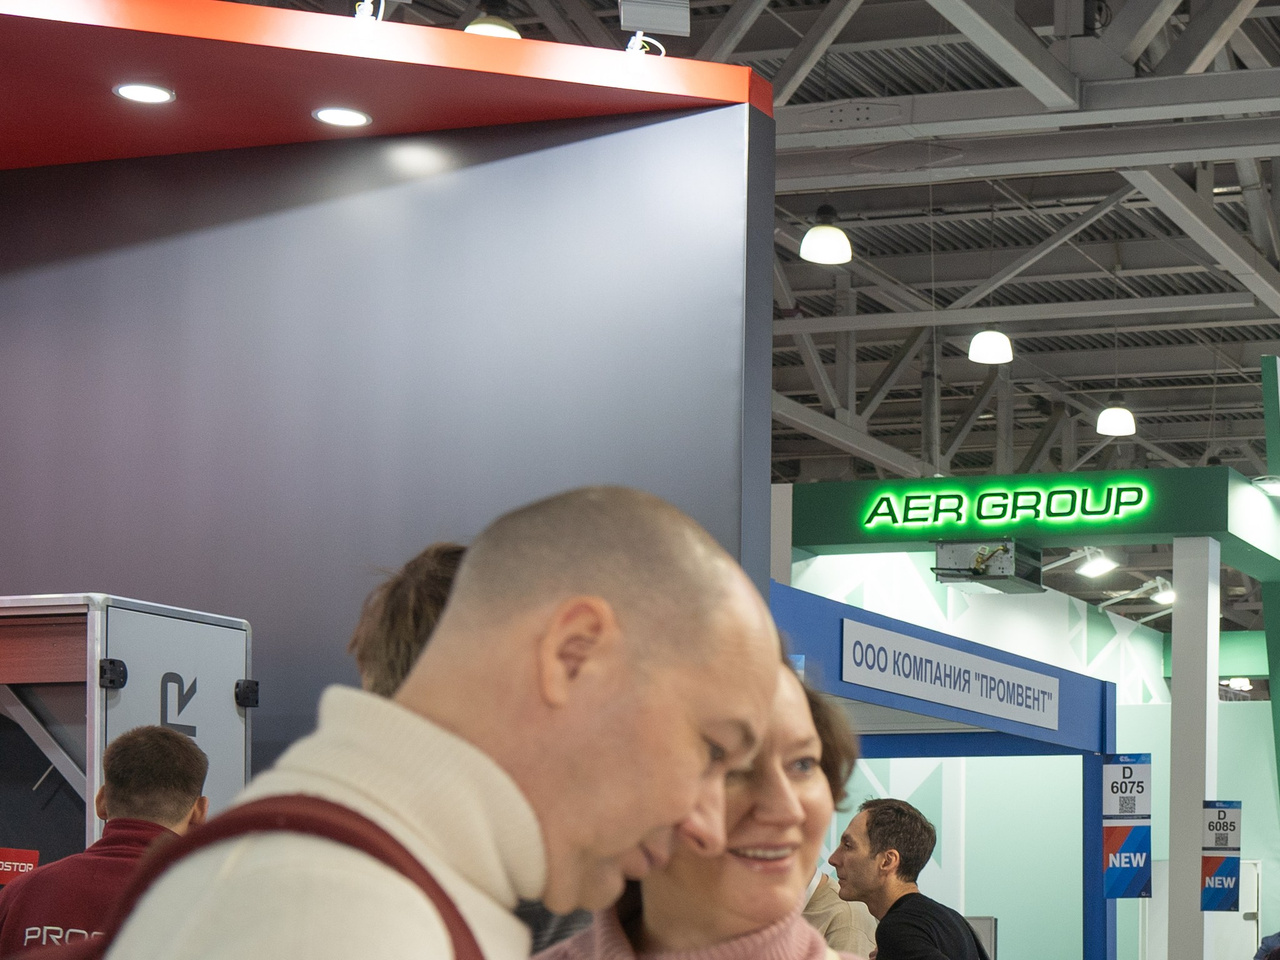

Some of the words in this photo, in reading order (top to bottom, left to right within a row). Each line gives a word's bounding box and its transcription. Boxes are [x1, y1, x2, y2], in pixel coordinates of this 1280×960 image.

[864, 493, 964, 526] AER
[976, 487, 1144, 521] GROUP
[853, 640, 888, 673] ООО
[893, 650, 971, 694] КОМПАНИЯ
[974, 672, 1053, 713] "ПРОМВЕНТ"
[1122, 766, 1133, 779] D
[1111, 781, 1144, 794] 6075
[1218, 810, 1227, 820] D
[1208, 821, 1236, 831] 6085
[1108, 853, 1146, 868] NEW
[1205, 877, 1236, 888] NEW
